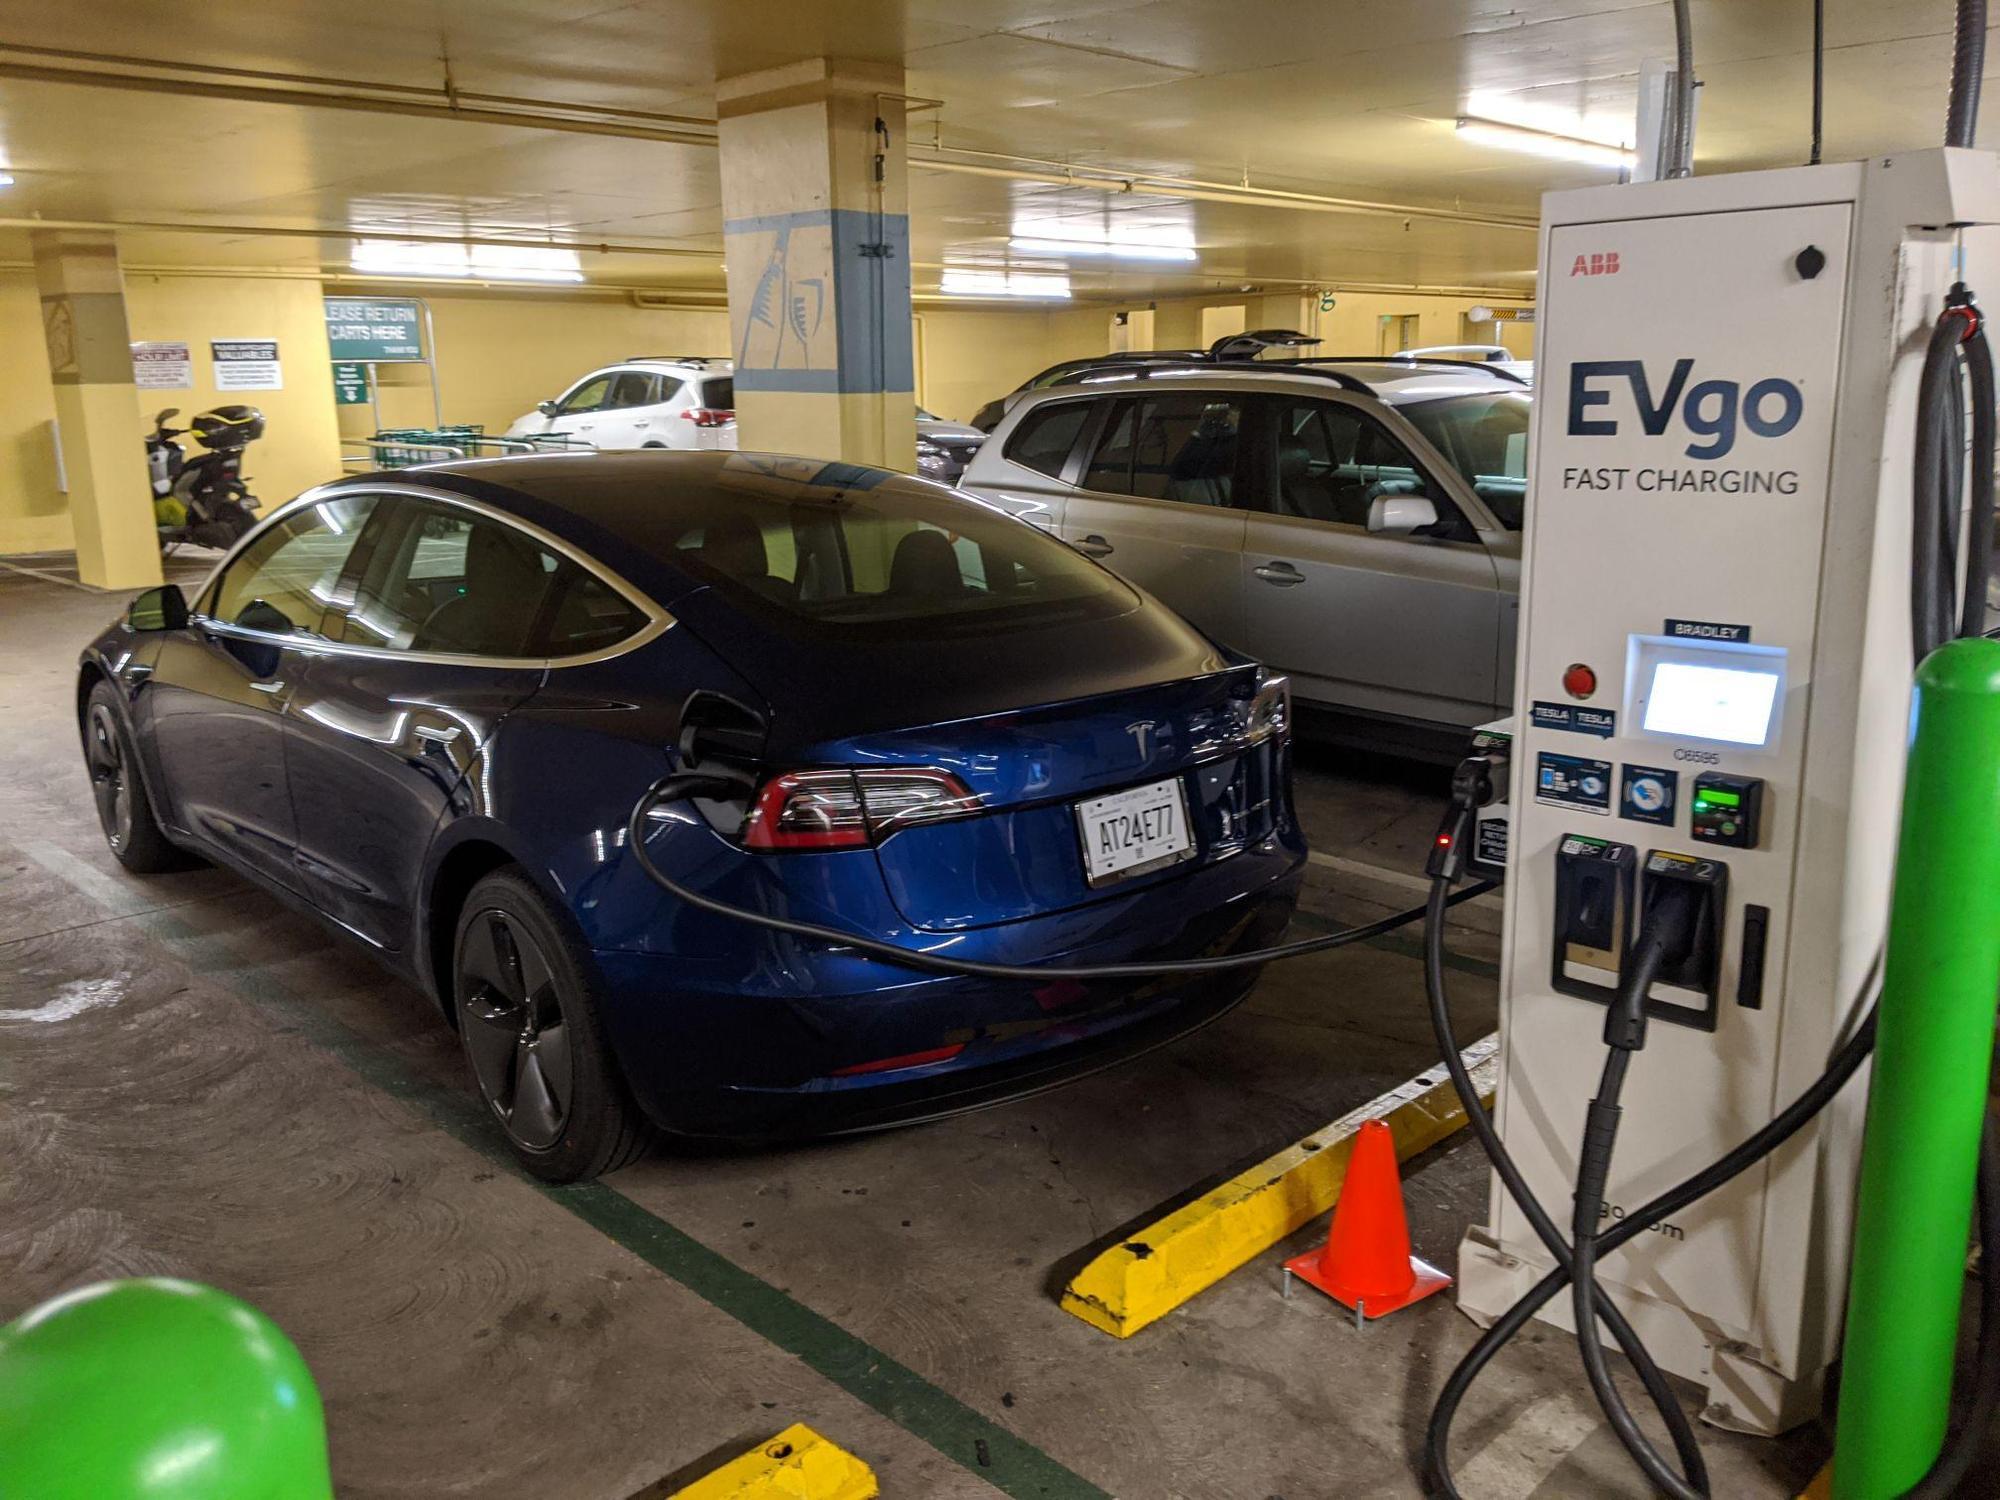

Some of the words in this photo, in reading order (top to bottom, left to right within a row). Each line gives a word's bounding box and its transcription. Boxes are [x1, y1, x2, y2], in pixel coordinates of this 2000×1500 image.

[1570, 252, 1620, 277] ABB
[324, 306, 364, 321] LEASE
[365, 307, 416, 322] RETURN
[329, 325, 370, 340] CARTS
[371, 325, 407, 340] HERE
[1567, 358, 1804, 461] EVgo
[1563, 468, 1631, 491] FAST
[1636, 468, 1799, 495] CHARGING
[1675, 623, 1741, 639] BRADLEY
[1535, 707, 1570, 720] TESLA
[1577, 712, 1613, 725] TESLA
[1100, 803, 1172, 855] AT24E77
[1695, 862, 1713, 879] 2
